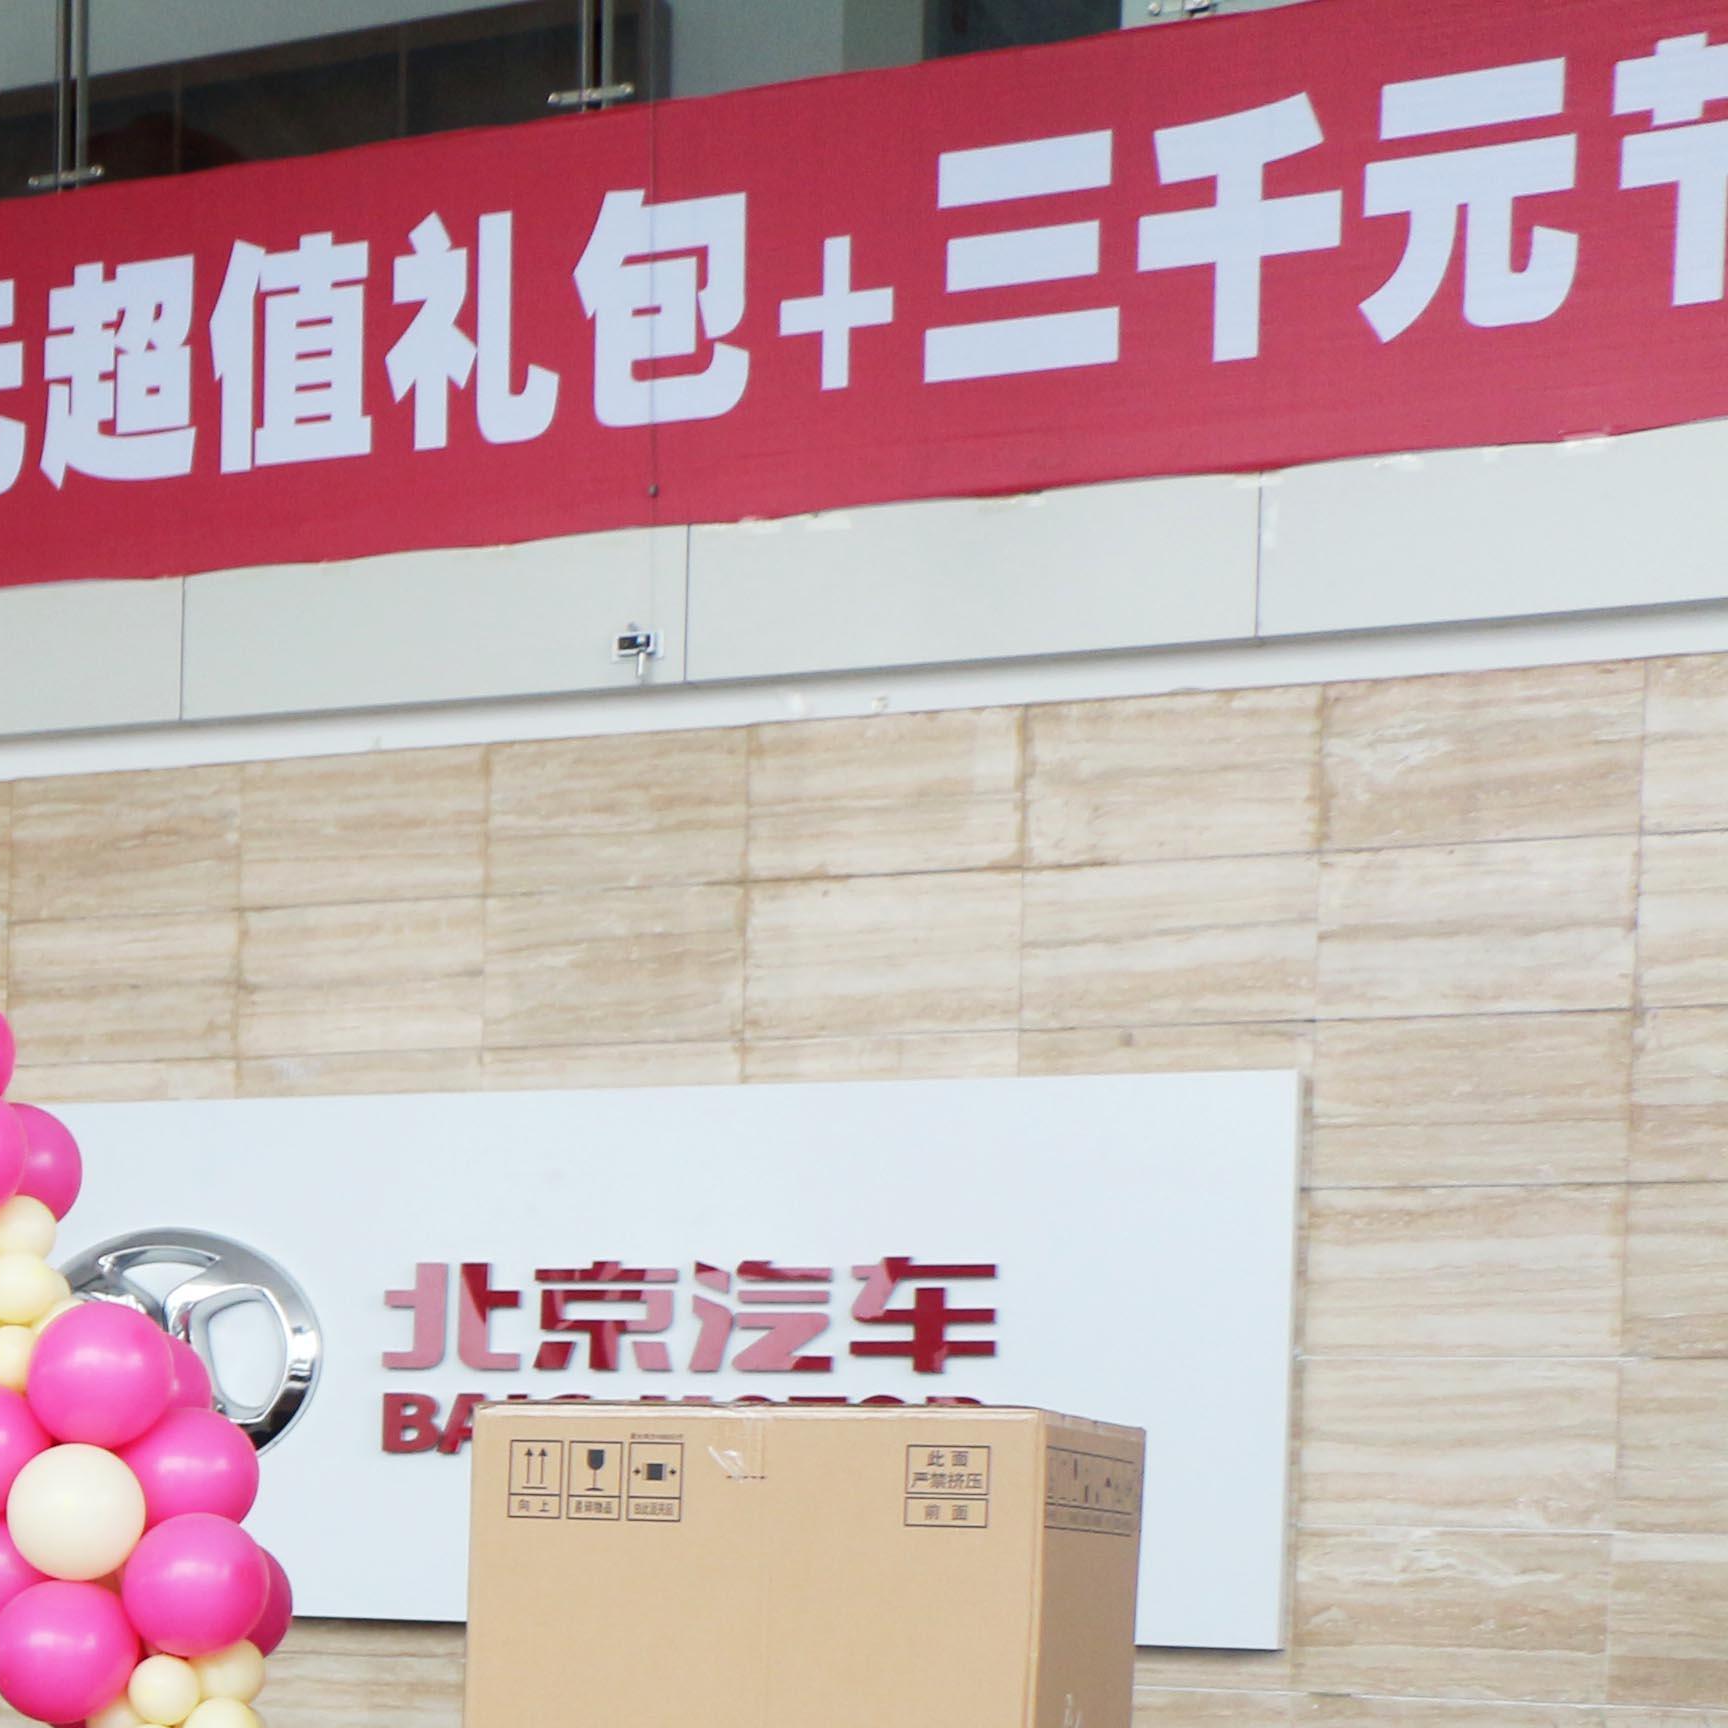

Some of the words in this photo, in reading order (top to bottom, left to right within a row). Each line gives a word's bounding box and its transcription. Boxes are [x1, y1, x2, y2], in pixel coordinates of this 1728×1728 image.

[381, 1255, 1000, 1374] 北京汽车
[926, 1449, 969, 1468] 此面
[910, 1471, 983, 1491] 严禁挤压
[923, 1503, 969, 1522] 前面
